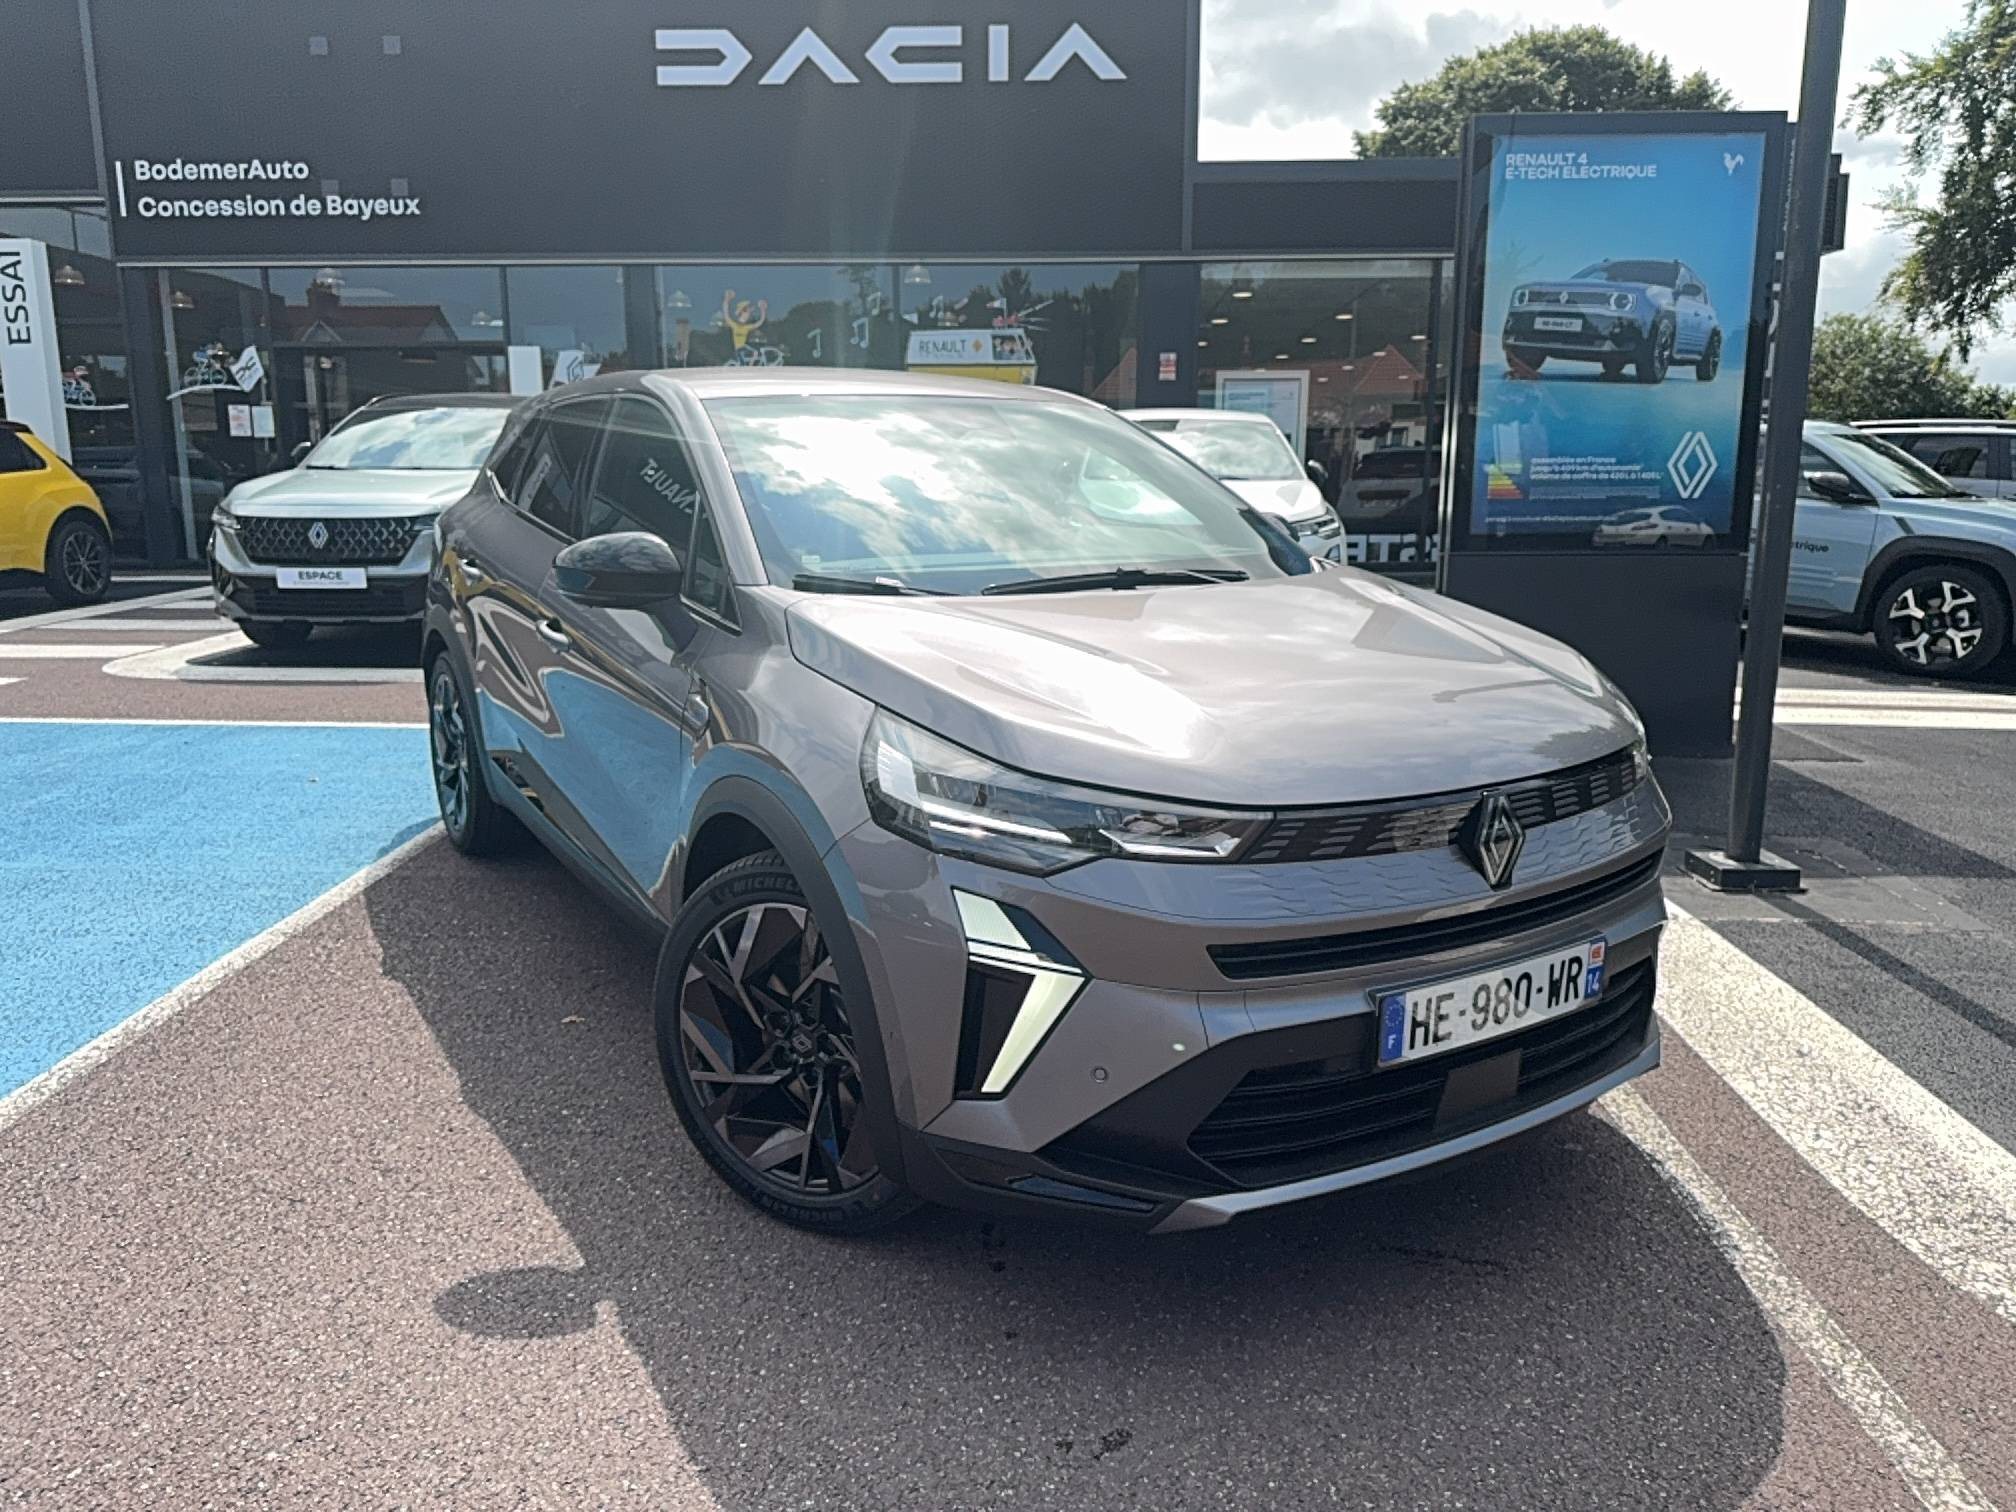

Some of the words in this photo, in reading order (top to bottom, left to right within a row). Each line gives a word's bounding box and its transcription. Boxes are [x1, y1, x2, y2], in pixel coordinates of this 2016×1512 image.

[655, 22, 1128, 86] DACIA
[1505, 153, 1575, 166] RENAULT
[1577, 152, 1588, 165] 4
[134, 159, 309, 182] BodemerAuto
[1505, 167, 1559, 179] E-TECH
[137, 196, 285, 217] Concession
[290, 196, 322, 216] de
[326, 196, 420, 220] Bayeux
[0, 251, 32, 345] ESSAI
[919, 340, 967, 353] RENAULT
[1795, 540, 1829, 553] trique
[298, 570, 343, 581] ESPACE
[733, 876, 802, 894] MICHEL
[1587, 973, 1600, 994] 14
[1408, 955, 1583, 1050] HE-980-WR
[1388, 1034, 1396, 1049] F
